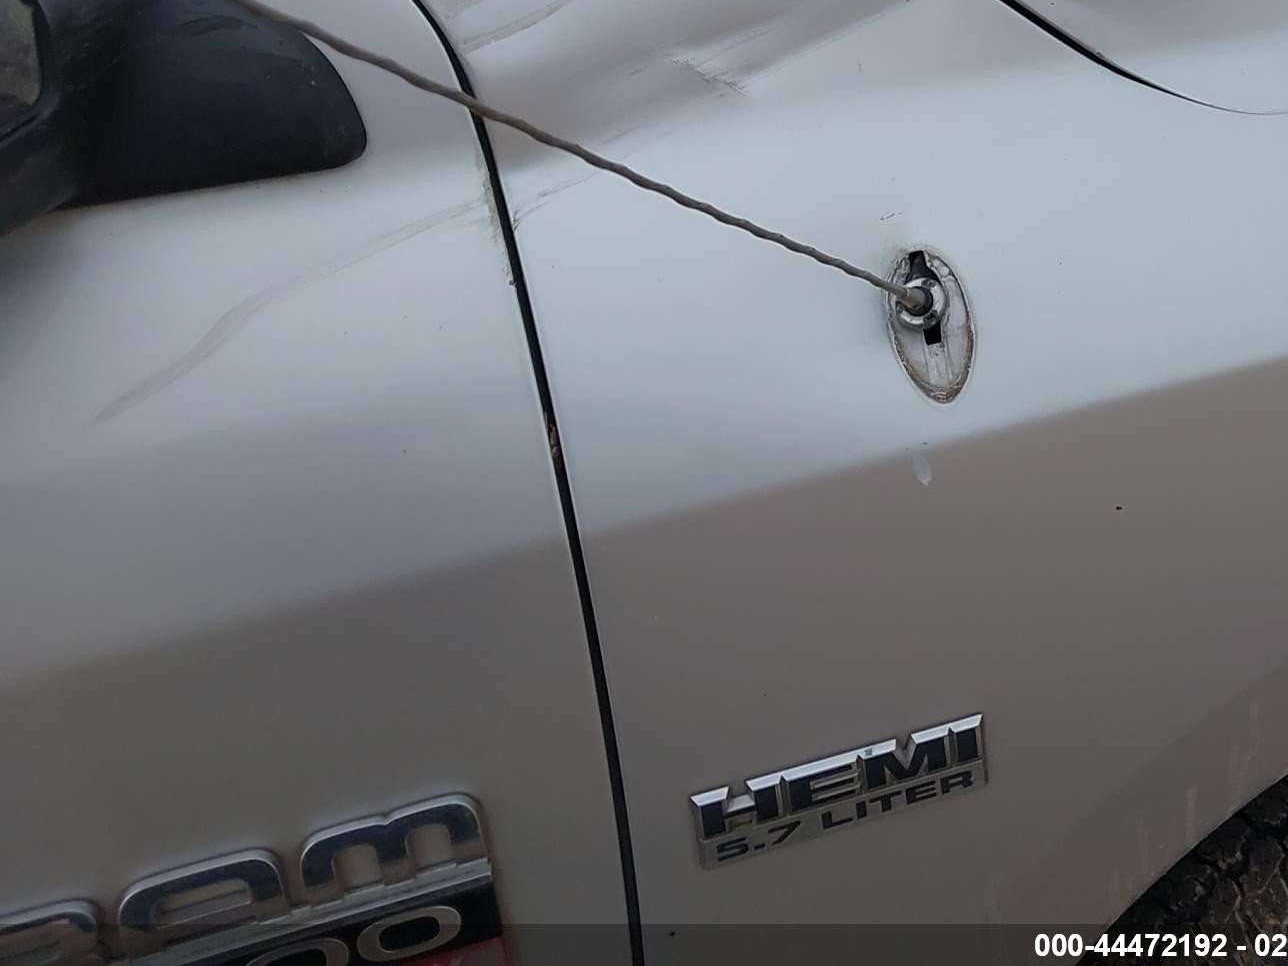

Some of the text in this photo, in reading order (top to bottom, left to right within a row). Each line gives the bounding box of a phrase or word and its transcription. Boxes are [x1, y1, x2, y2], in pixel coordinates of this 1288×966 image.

[690, 713, 987, 840] HEMI
[716, 770, 974, 862] 5.7 LITER
